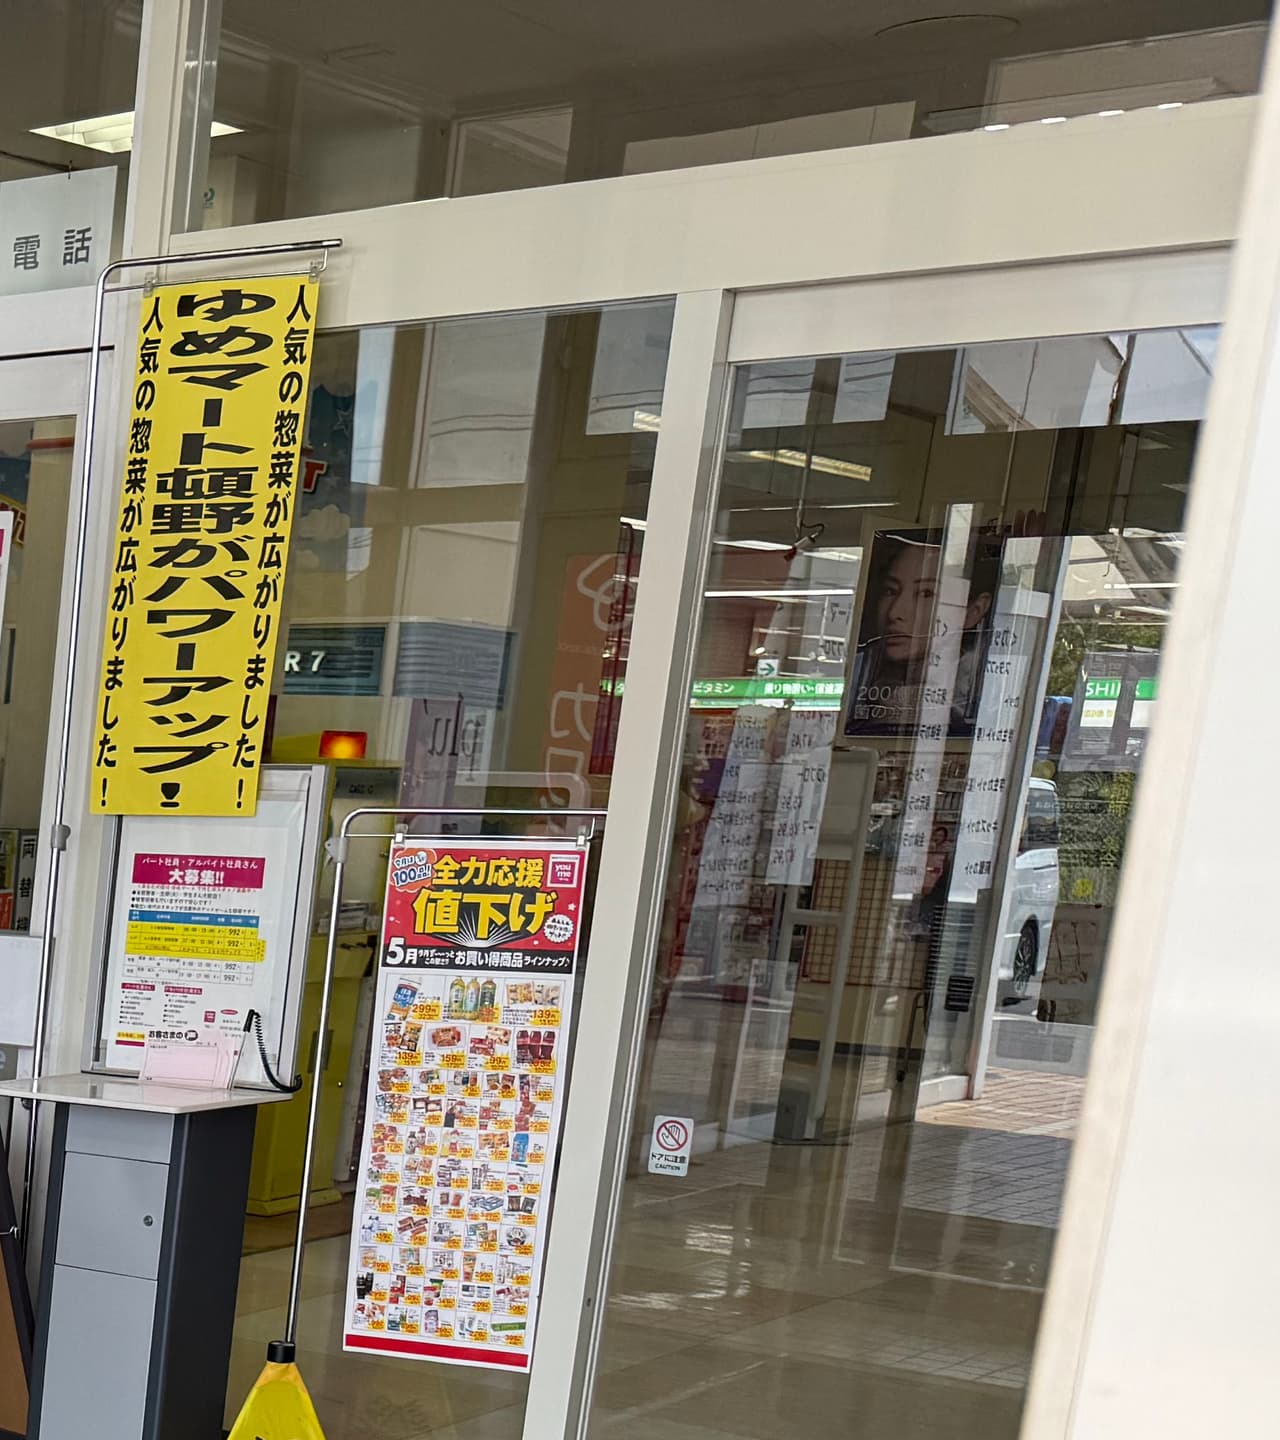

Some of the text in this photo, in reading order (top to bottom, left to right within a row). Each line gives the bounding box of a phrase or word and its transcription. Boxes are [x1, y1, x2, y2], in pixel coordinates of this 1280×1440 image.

[12, 227, 93, 272] 電話
[311, 651, 327, 672] 7
[142, 857, 259, 870] パート社員・アルバイト社員さん
[431, 854, 544, 889] 全力応援
[412, 888, 559, 941] 値下げ
[385, 937, 418, 966] 5月
[455, 951, 523, 968] お買い得商品
